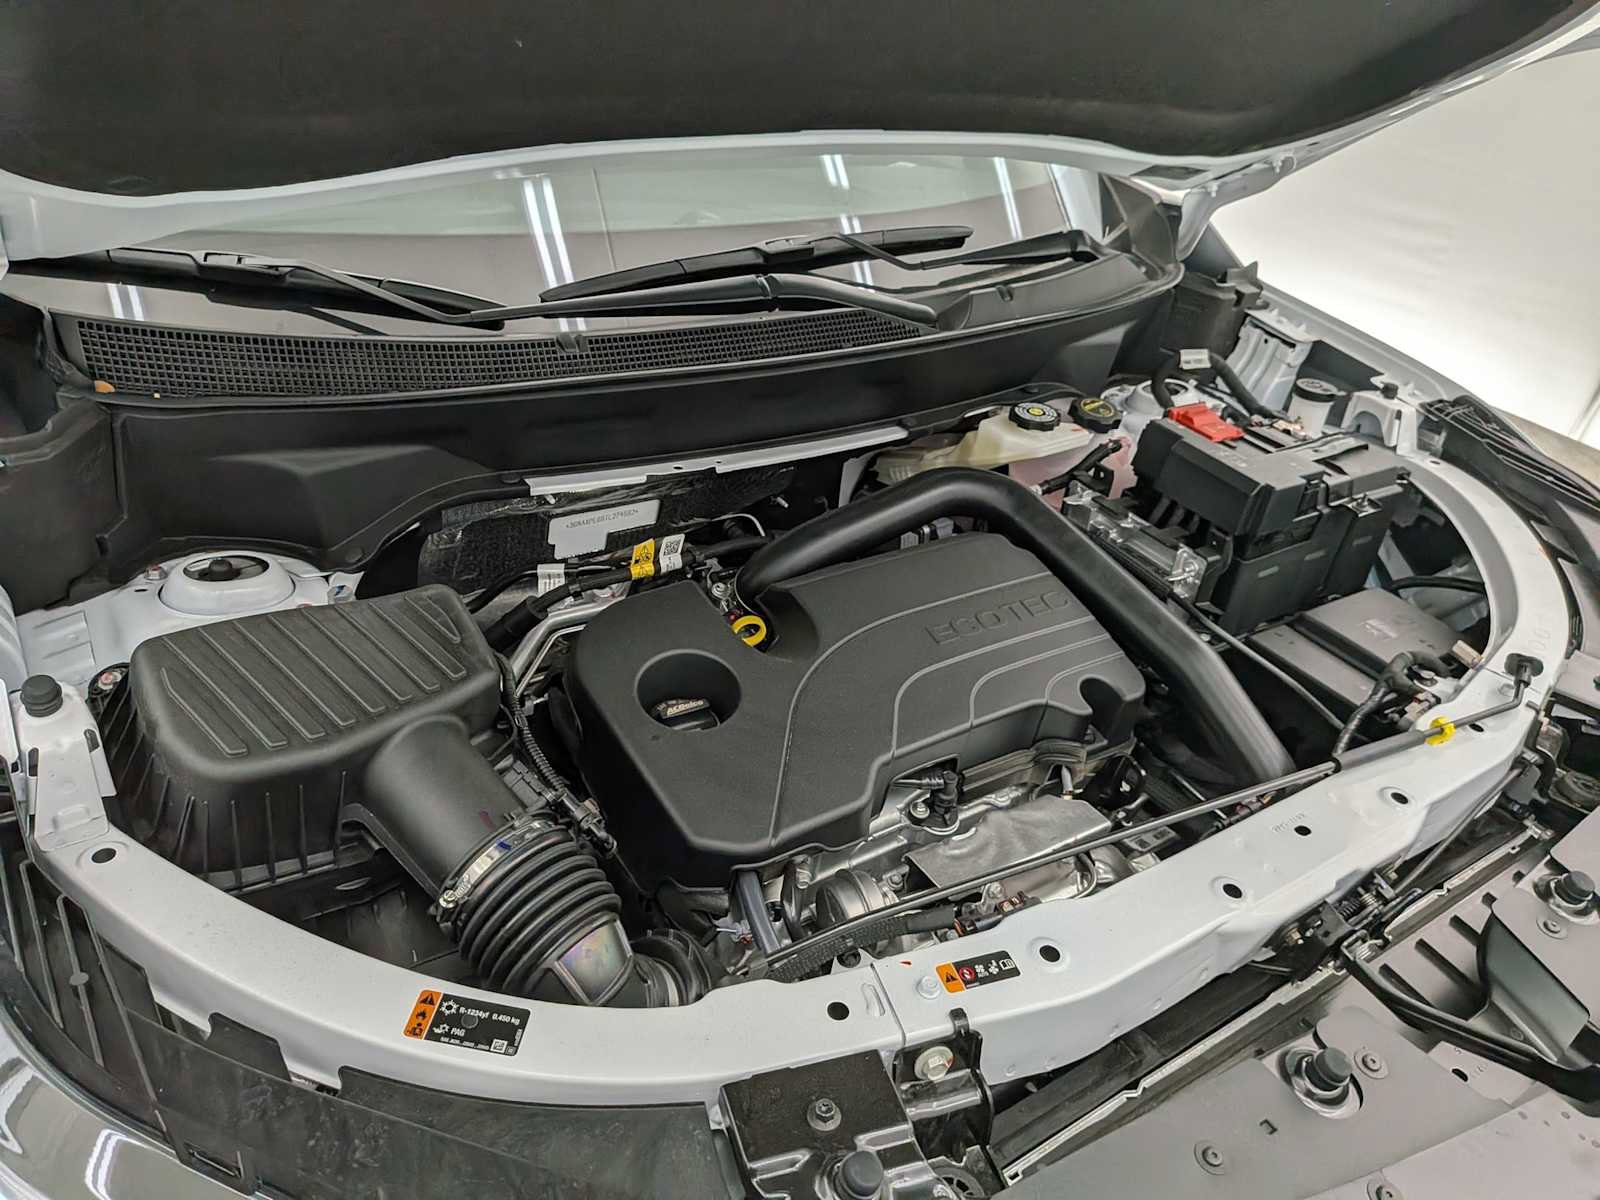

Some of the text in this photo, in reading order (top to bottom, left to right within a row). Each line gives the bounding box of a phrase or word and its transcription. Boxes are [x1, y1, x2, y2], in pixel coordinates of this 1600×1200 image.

[925, 592, 1071, 645] ECOTEC
[666, 700, 704, 716] ACDelco
[459, 1006, 521, 1026] R-1234yf 0.450 kg
[450, 1027, 466, 1037] PAG
